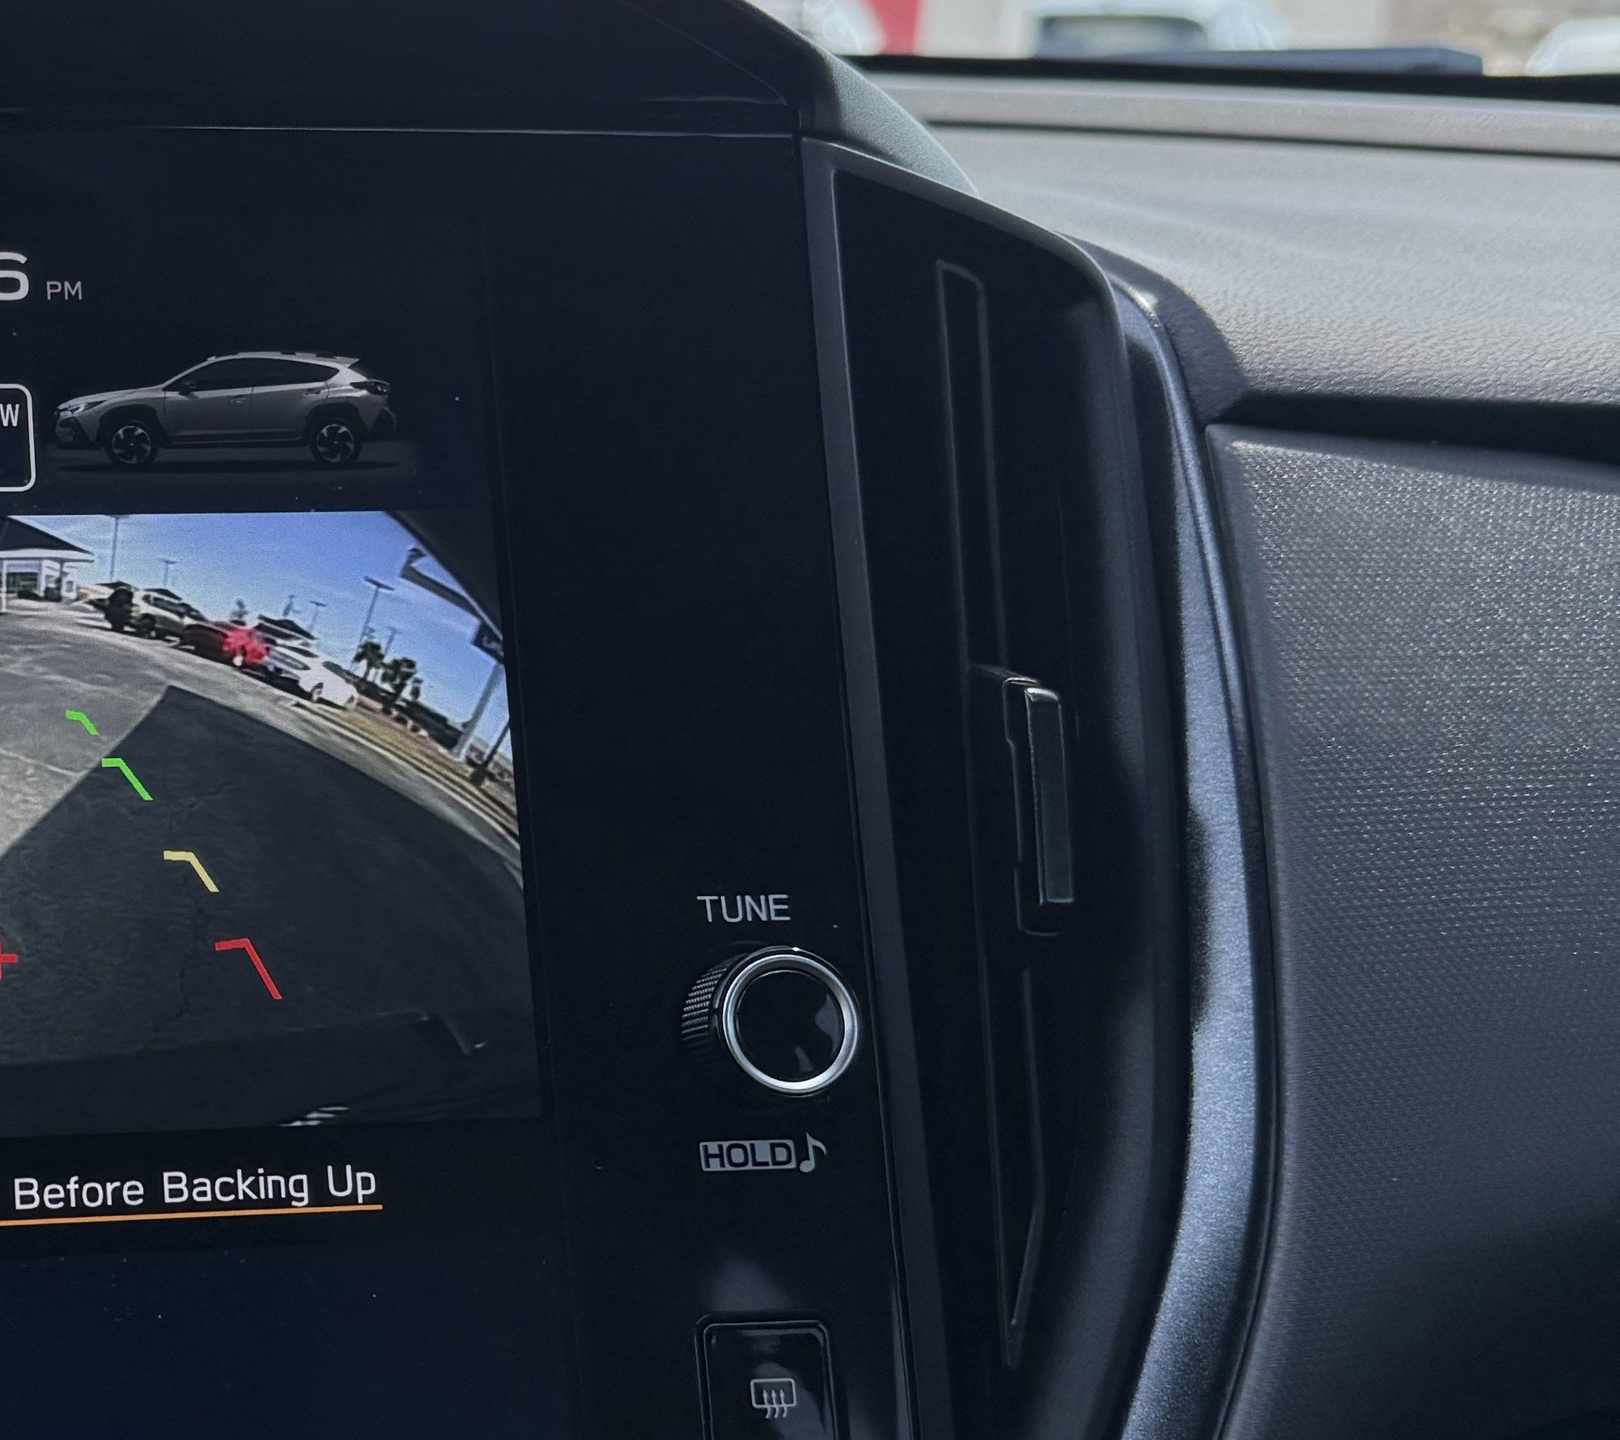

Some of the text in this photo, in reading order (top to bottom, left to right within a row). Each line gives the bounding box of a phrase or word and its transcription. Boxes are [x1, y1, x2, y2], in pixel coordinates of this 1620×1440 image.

[46, 279, 82, 301] PM
[696, 893, 791, 923] TUNE
[702, 1142, 793, 1169] HOLD
[13, 1174, 145, 1211] Before
[162, 1165, 310, 1207] Backing
[327, 1164, 378, 1205] Up
